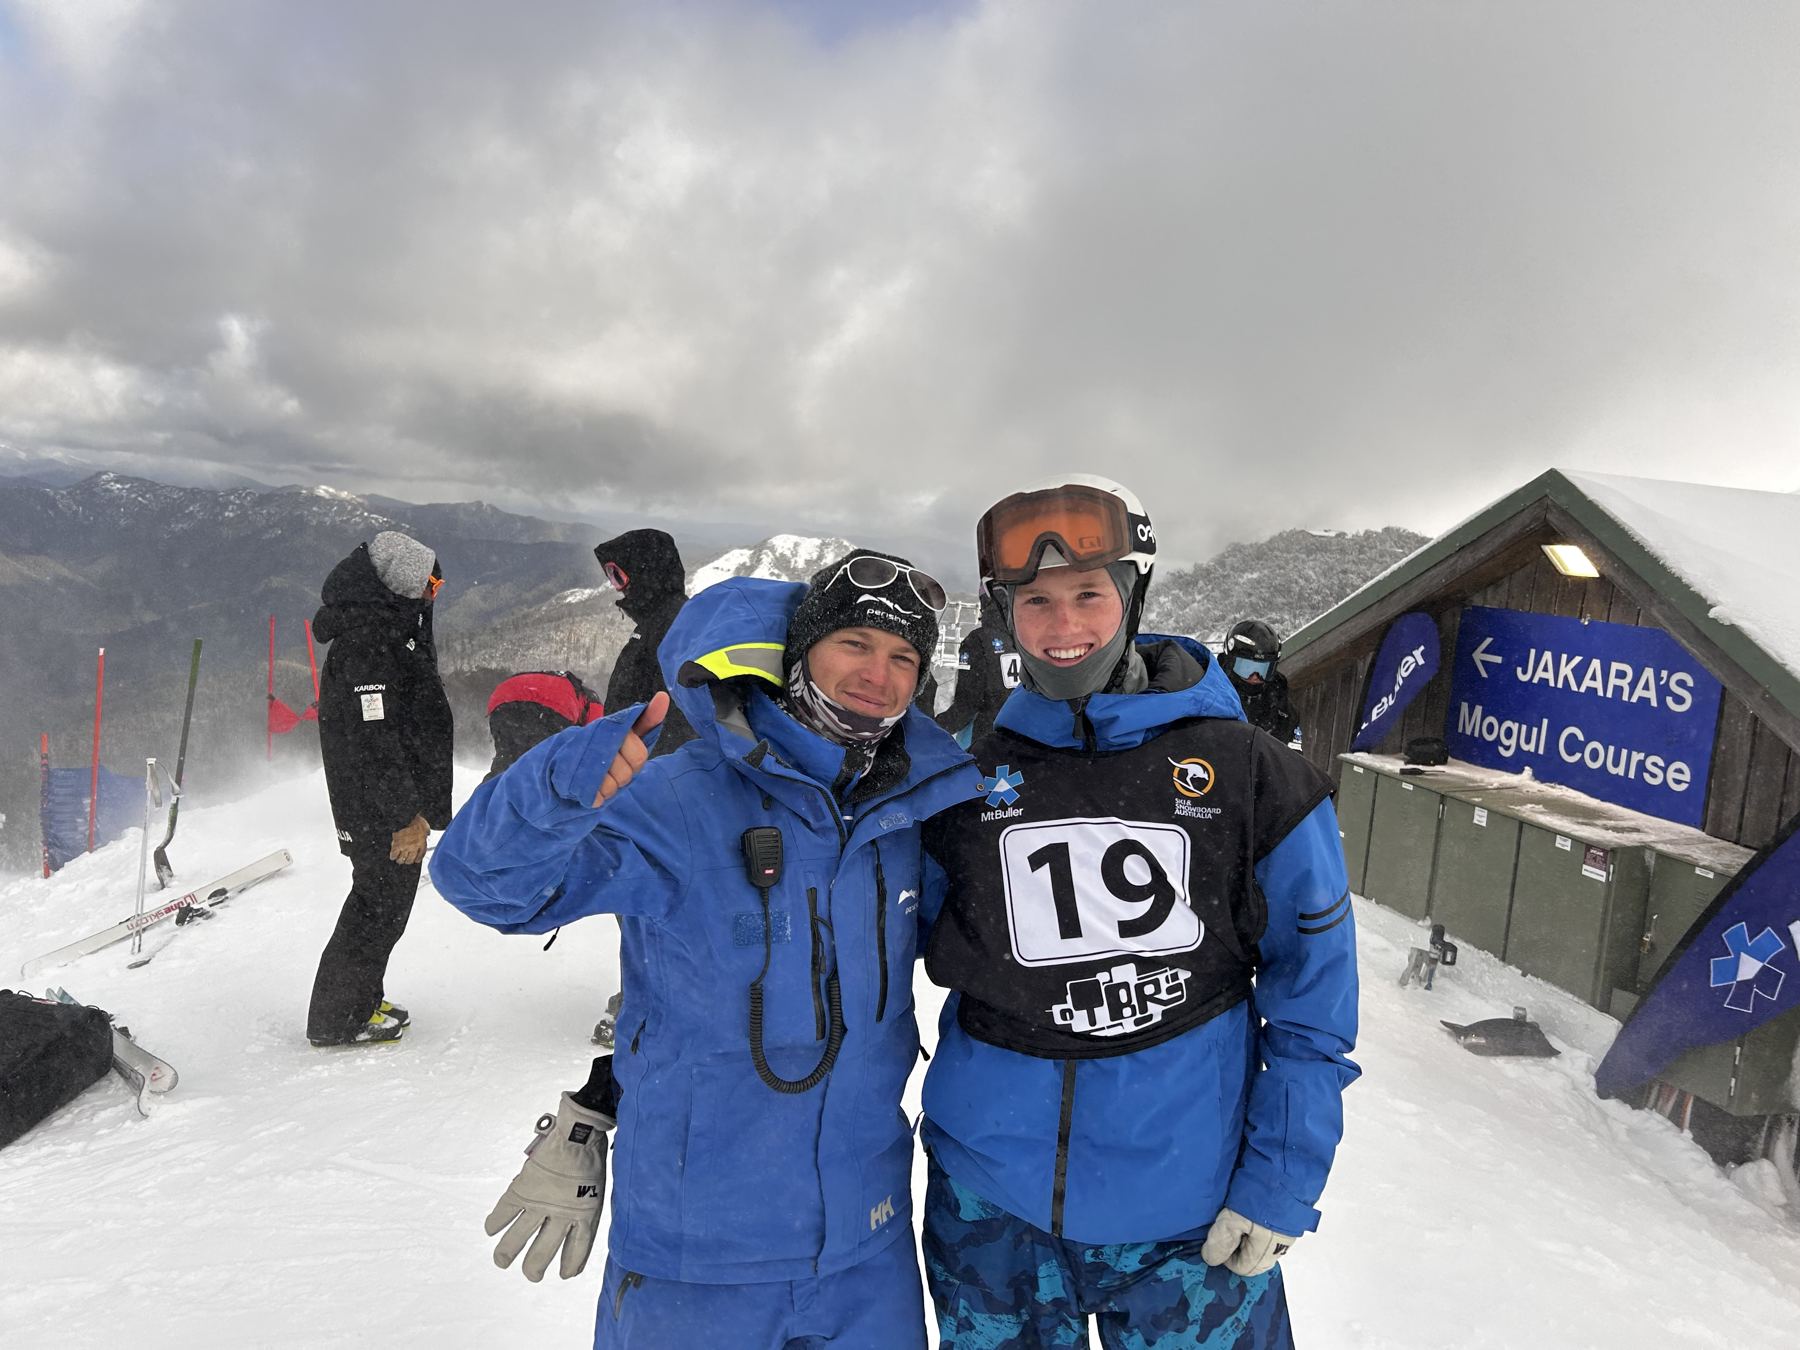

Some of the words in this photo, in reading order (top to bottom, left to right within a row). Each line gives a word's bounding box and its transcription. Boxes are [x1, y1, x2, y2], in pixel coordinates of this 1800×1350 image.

[866, 608, 911, 627] perisher
[353, 684, 386, 693] KARBON
[1457, 701, 1549, 758] Mogul
[1558, 726, 1692, 793] Course
[1174, 803, 1222, 815] SNOWBOARD
[1174, 808, 1213, 820] AUSTRALIA
[1026, 838, 1176, 940] 19
[870, 1194, 895, 1231] HH
